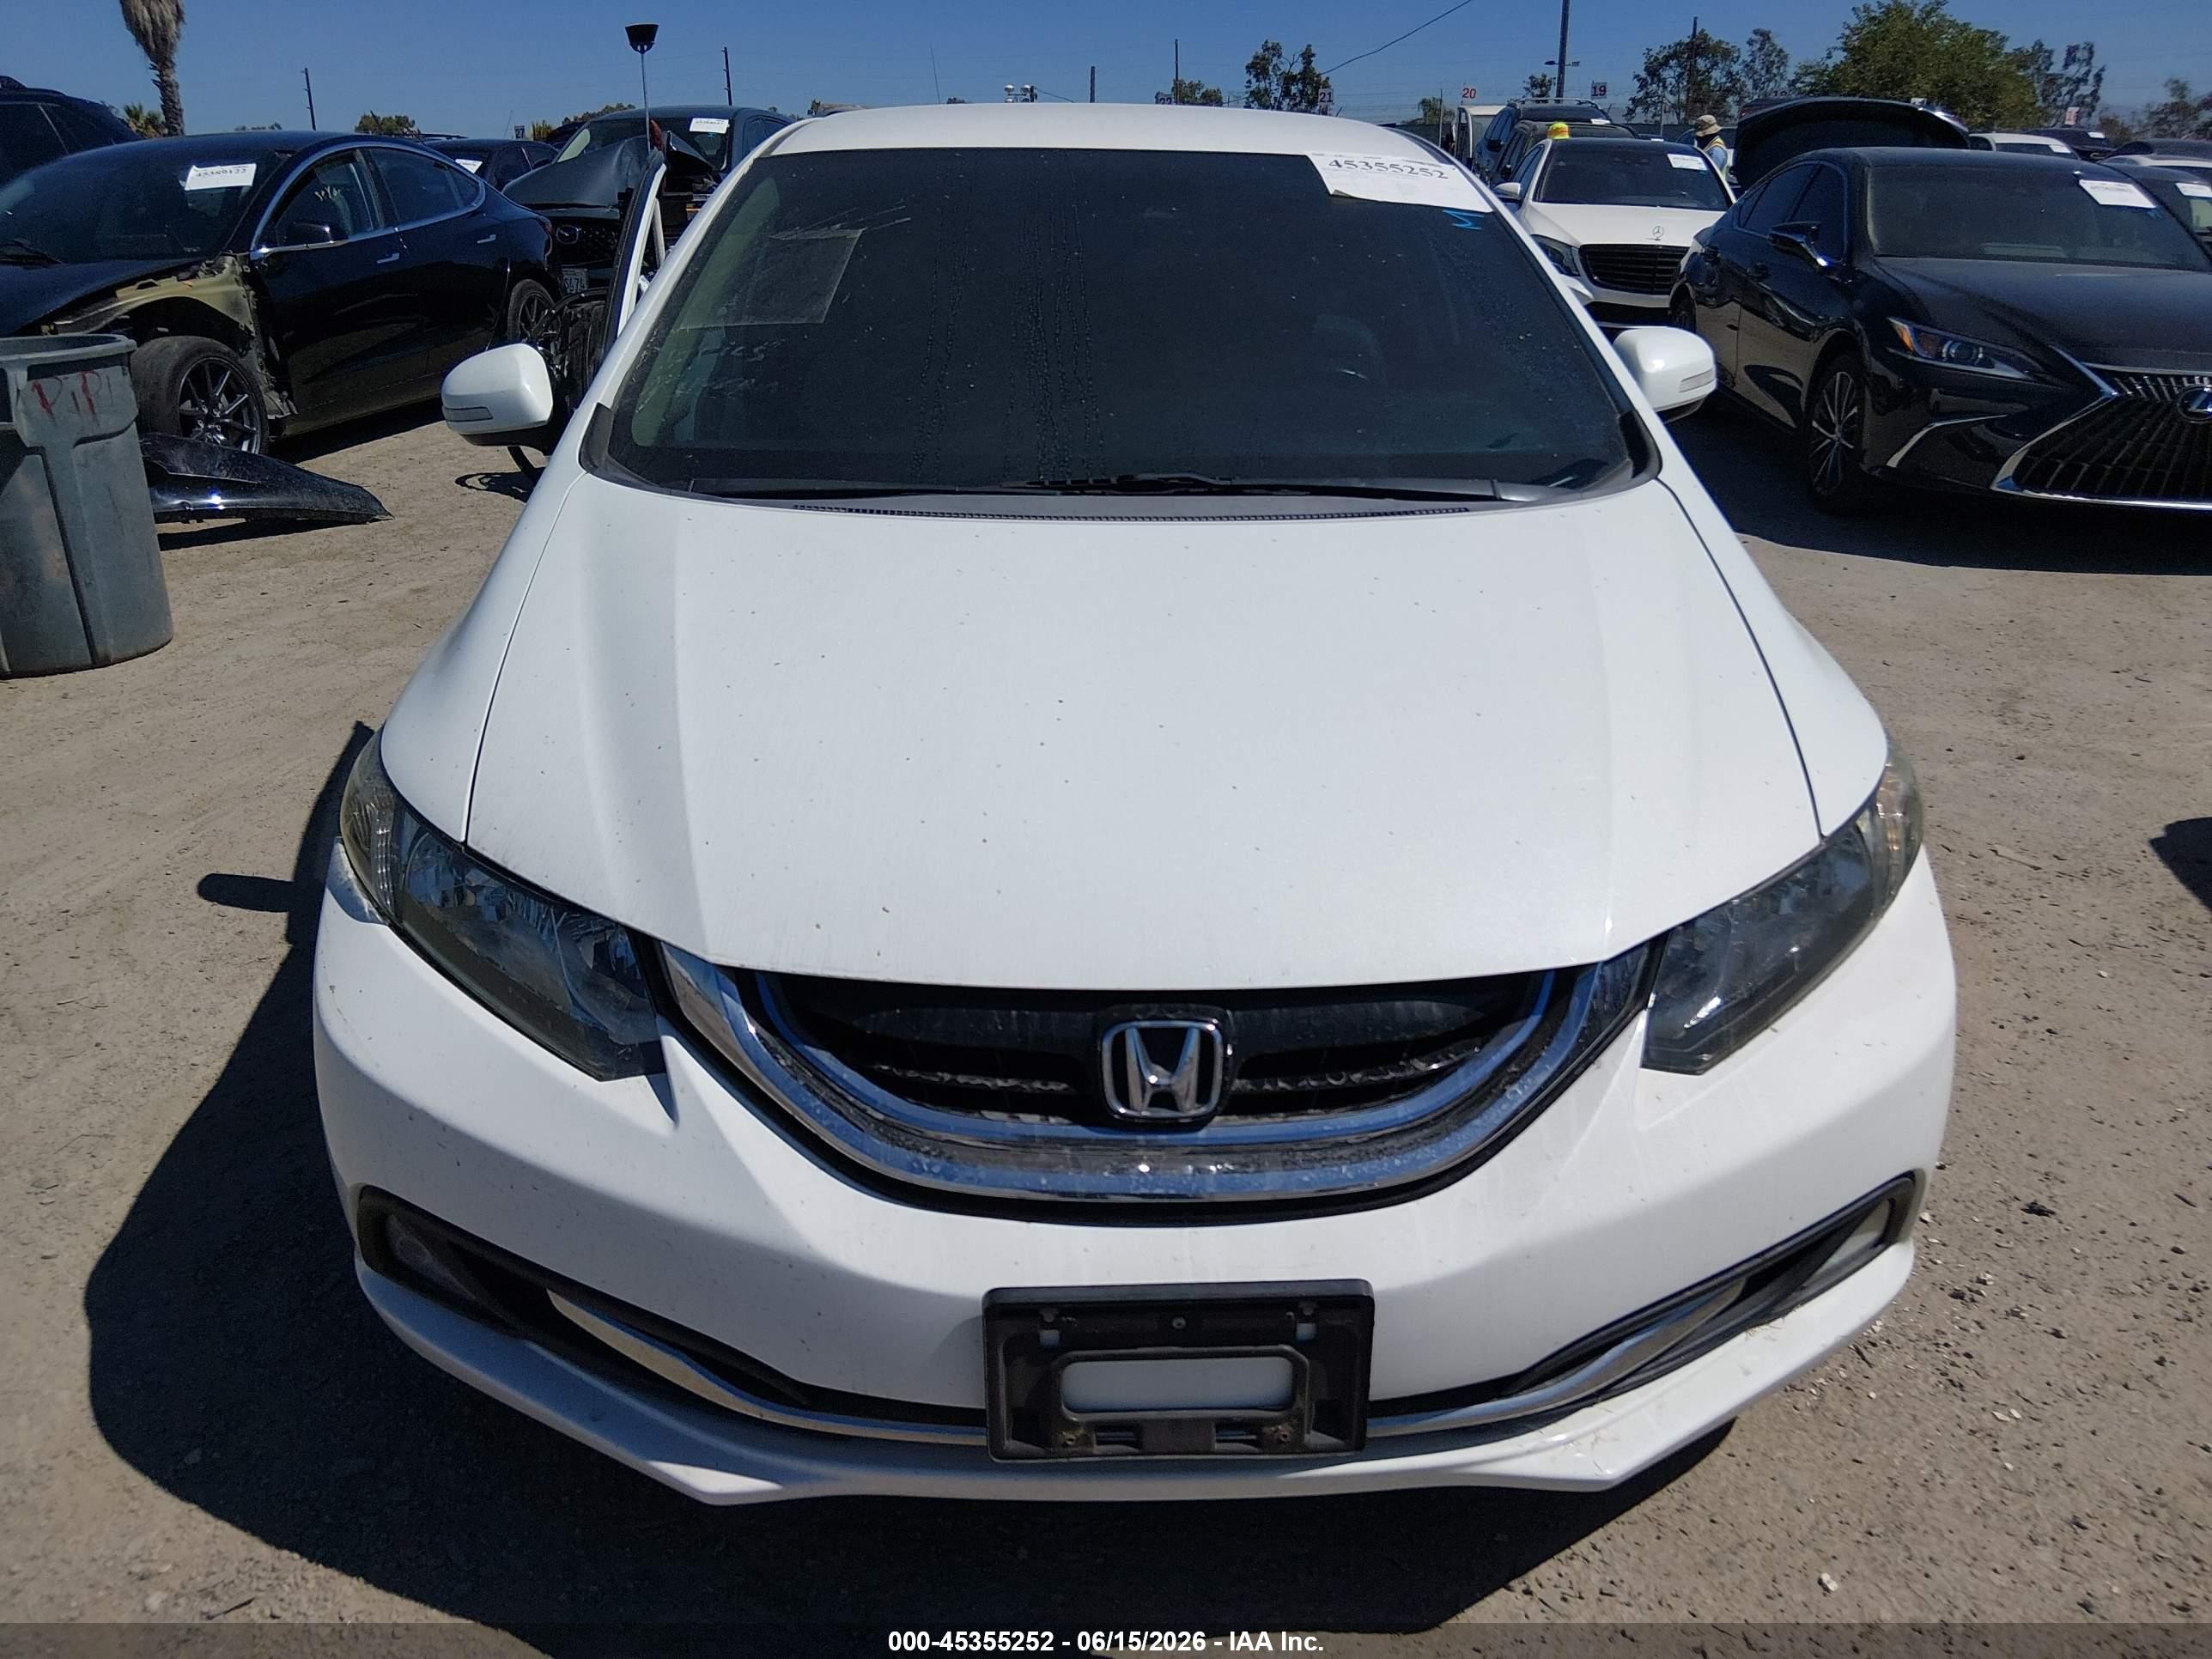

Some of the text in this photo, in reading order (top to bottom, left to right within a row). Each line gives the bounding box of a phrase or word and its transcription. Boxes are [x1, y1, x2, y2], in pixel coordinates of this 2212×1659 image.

[1462, 88, 1477, 99] 20
[1591, 85, 1607, 96] 19
[1319, 92, 1333, 103] 21
[1328, 159, 1449, 179] 45355252
